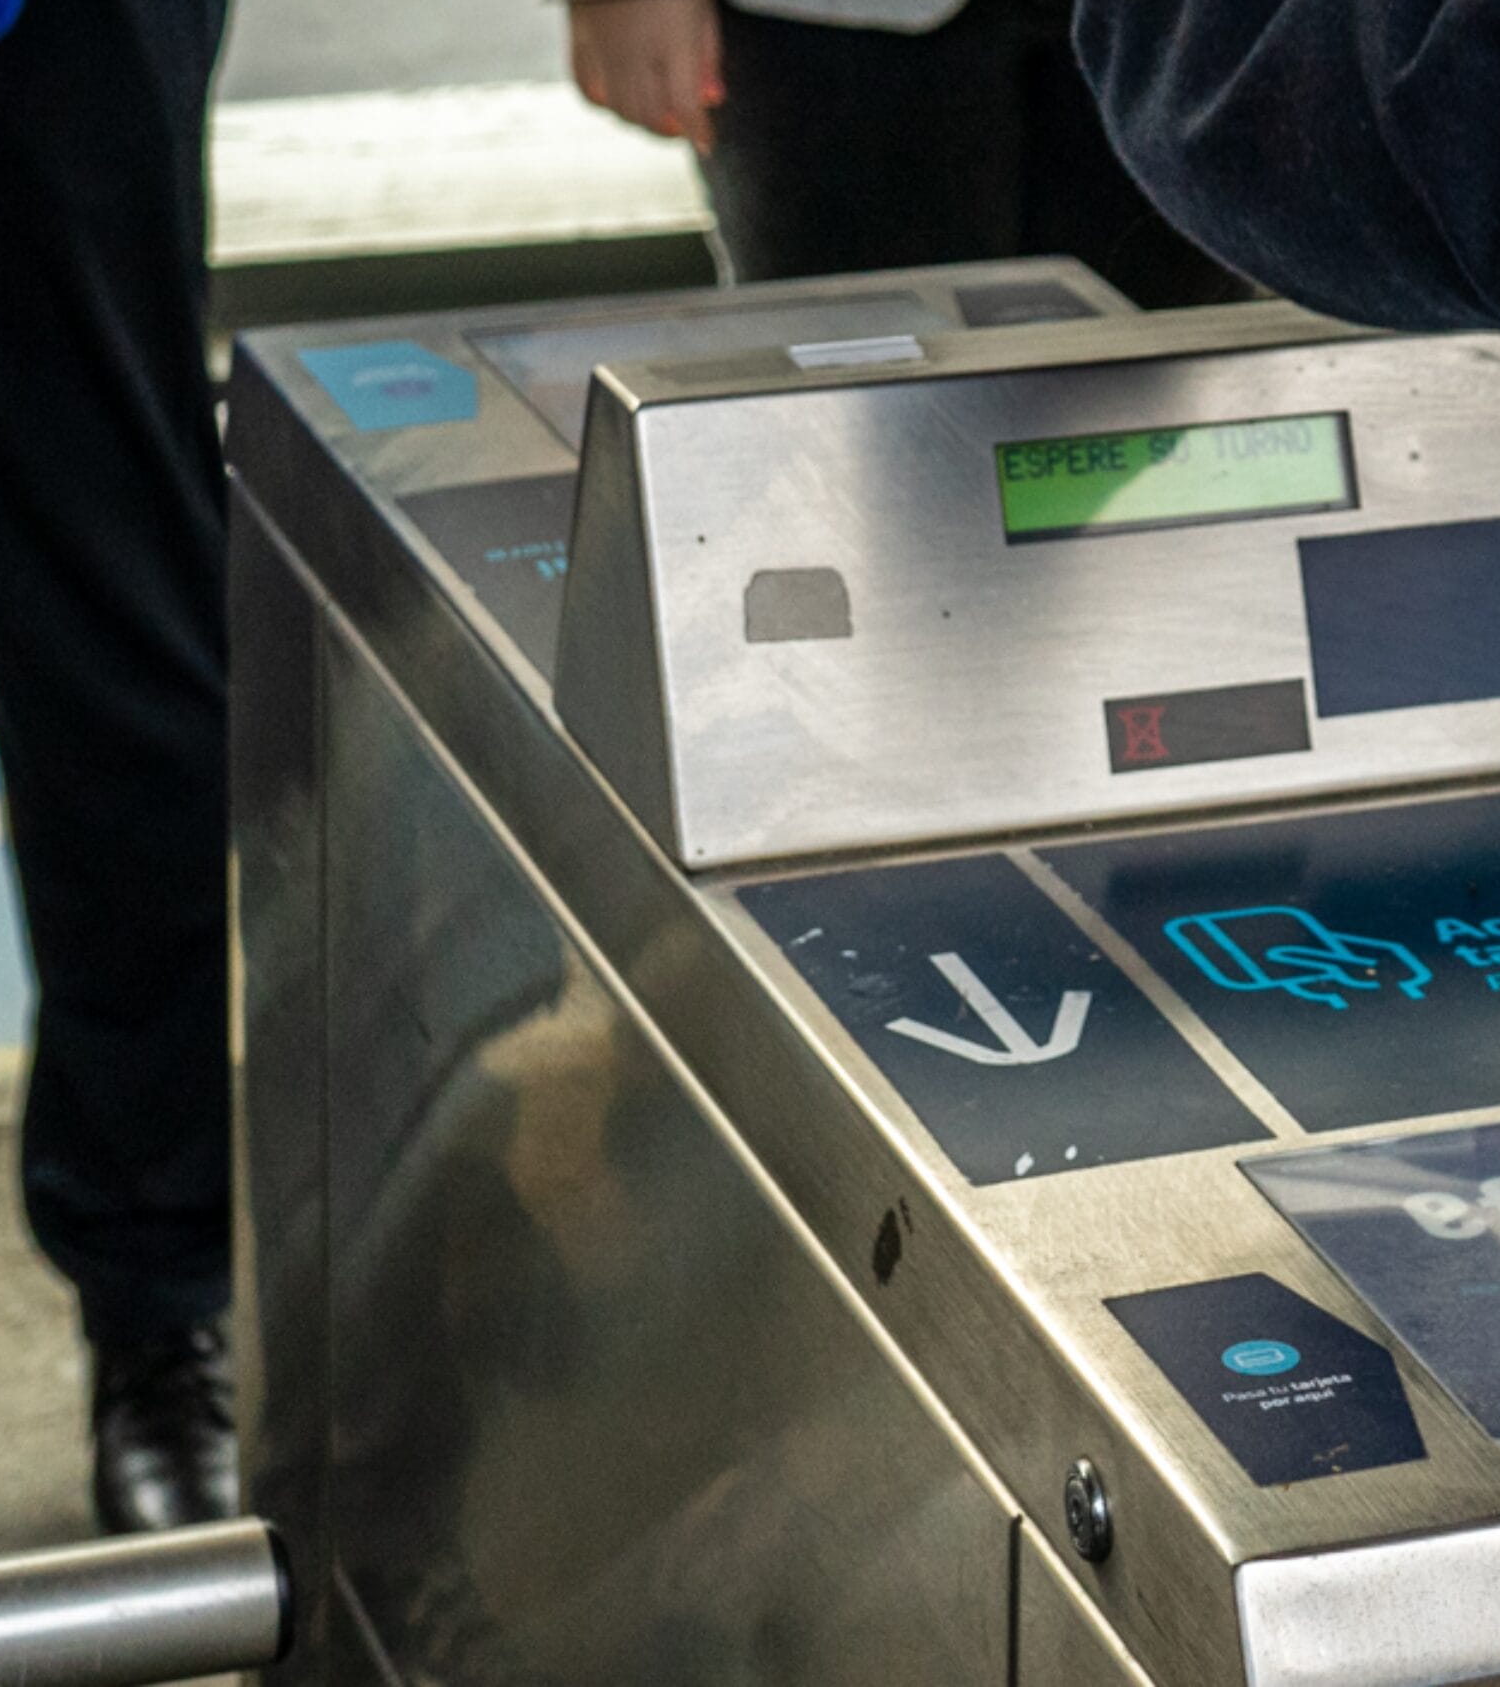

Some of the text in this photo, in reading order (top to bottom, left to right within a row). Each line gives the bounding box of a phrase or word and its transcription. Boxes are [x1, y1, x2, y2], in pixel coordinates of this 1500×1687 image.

[1003, 421, 1312, 482] ESPERE SU TURNO
[1221, 1373, 1353, 1403] Pasa tu tarjeta
[1259, 1396, 1291, 1411] por
